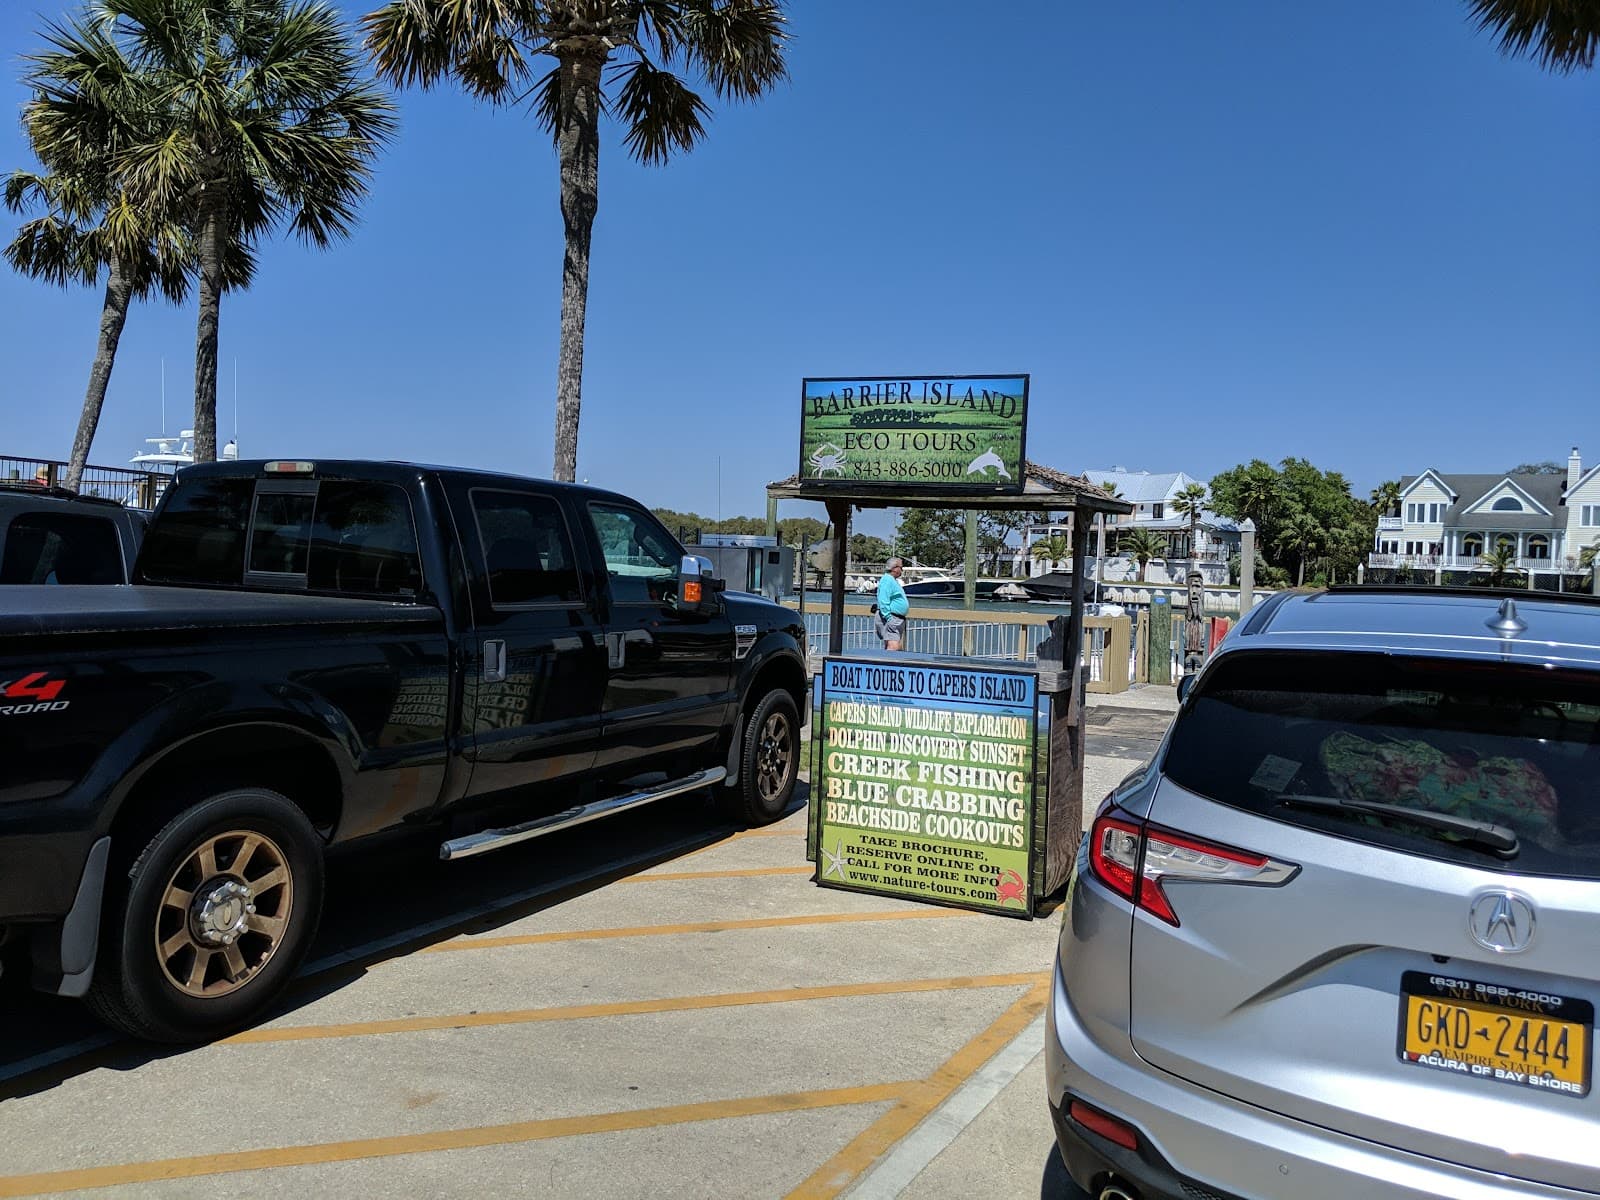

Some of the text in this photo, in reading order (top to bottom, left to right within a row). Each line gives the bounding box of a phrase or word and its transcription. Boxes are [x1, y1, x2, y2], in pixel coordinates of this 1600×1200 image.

[813, 382, 1017, 419] BARRIER ISLAND
[843, 432, 976, 451] ECO TOURS
[853, 461, 962, 478] 843-886-5000
[831, 665, 1027, 703] BOAT TOURS TO CAPERS ISLAND
[829, 702, 1027, 740] CAPERS ISLAND WILDLIFE EXPLORATION
[828, 726, 1027, 766] DOLPHIN DISCOVERY SUNSET
[827, 752, 1026, 794] CREEK FISHING
[826, 777, 1026, 822] BLUE CRABBING
[826, 801, 1024, 848] BEACHSIDE COOKOUTS
[859, 835, 898, 848] TAKE
[846, 845, 1000, 875] RESERVE ONLINE OR
[846, 857, 1000, 888] CALL FOR MORE INFO
[849, 869, 997, 901] www.nature-tours.com
[1448, 987, 1544, 1013] NEW YORK
[1418, 1003, 1570, 1069] GKD 2444
[1417, 1055, 1468, 1072] ACURA
[1471, 1064, 1491, 1076] OF
[1495, 1069, 1526, 1083] BAY
[1528, 1075, 1583, 1094] SHORE
[1444, 1048, 1542, 1075] EMPIRE STATE
